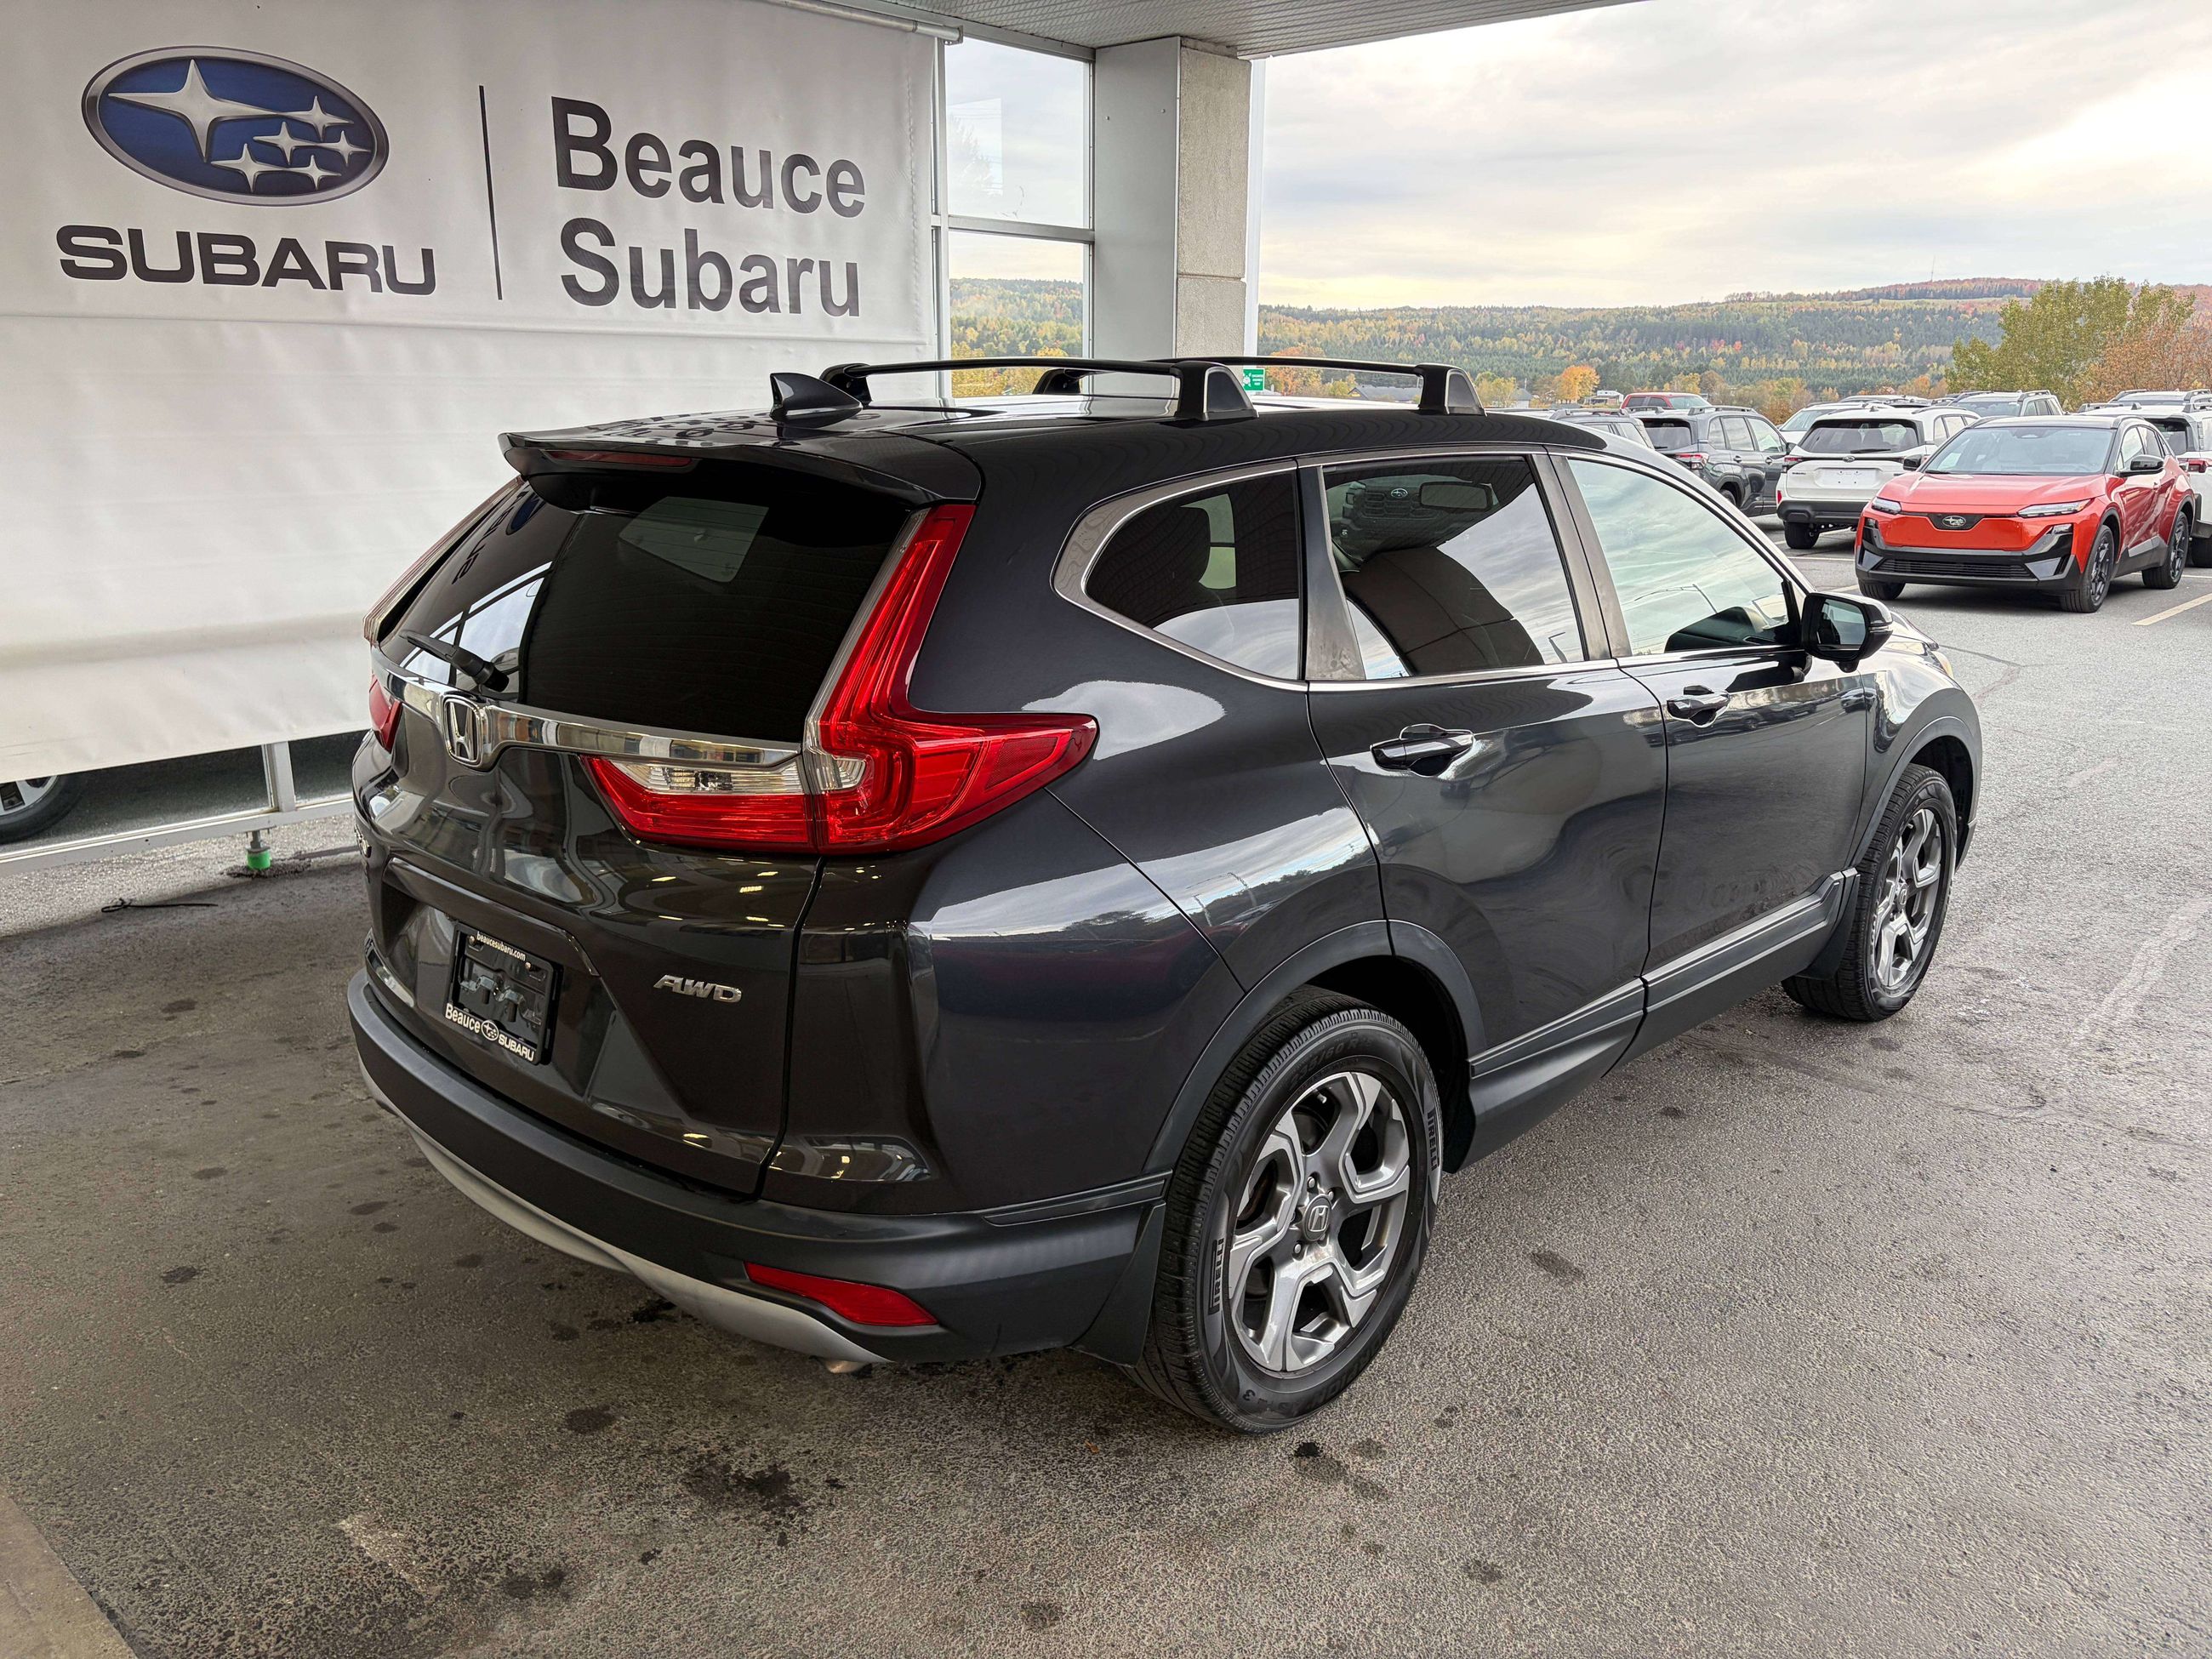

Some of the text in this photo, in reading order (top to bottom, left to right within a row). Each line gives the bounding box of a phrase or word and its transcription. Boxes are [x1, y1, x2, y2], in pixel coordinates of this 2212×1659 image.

[550, 95, 865, 219] Beauce
[56, 225, 436, 295] SUBARU
[561, 217, 860, 316] Subaru
[476, 930, 527, 961] beaucesubaru.com
[652, 974, 743, 1003] AWD
[445, 1001, 535, 1063] Beauce SUBARU
[1427, 1108, 1440, 1172] PIRELLI
[1208, 1237, 1224, 1315] PIRELLI
